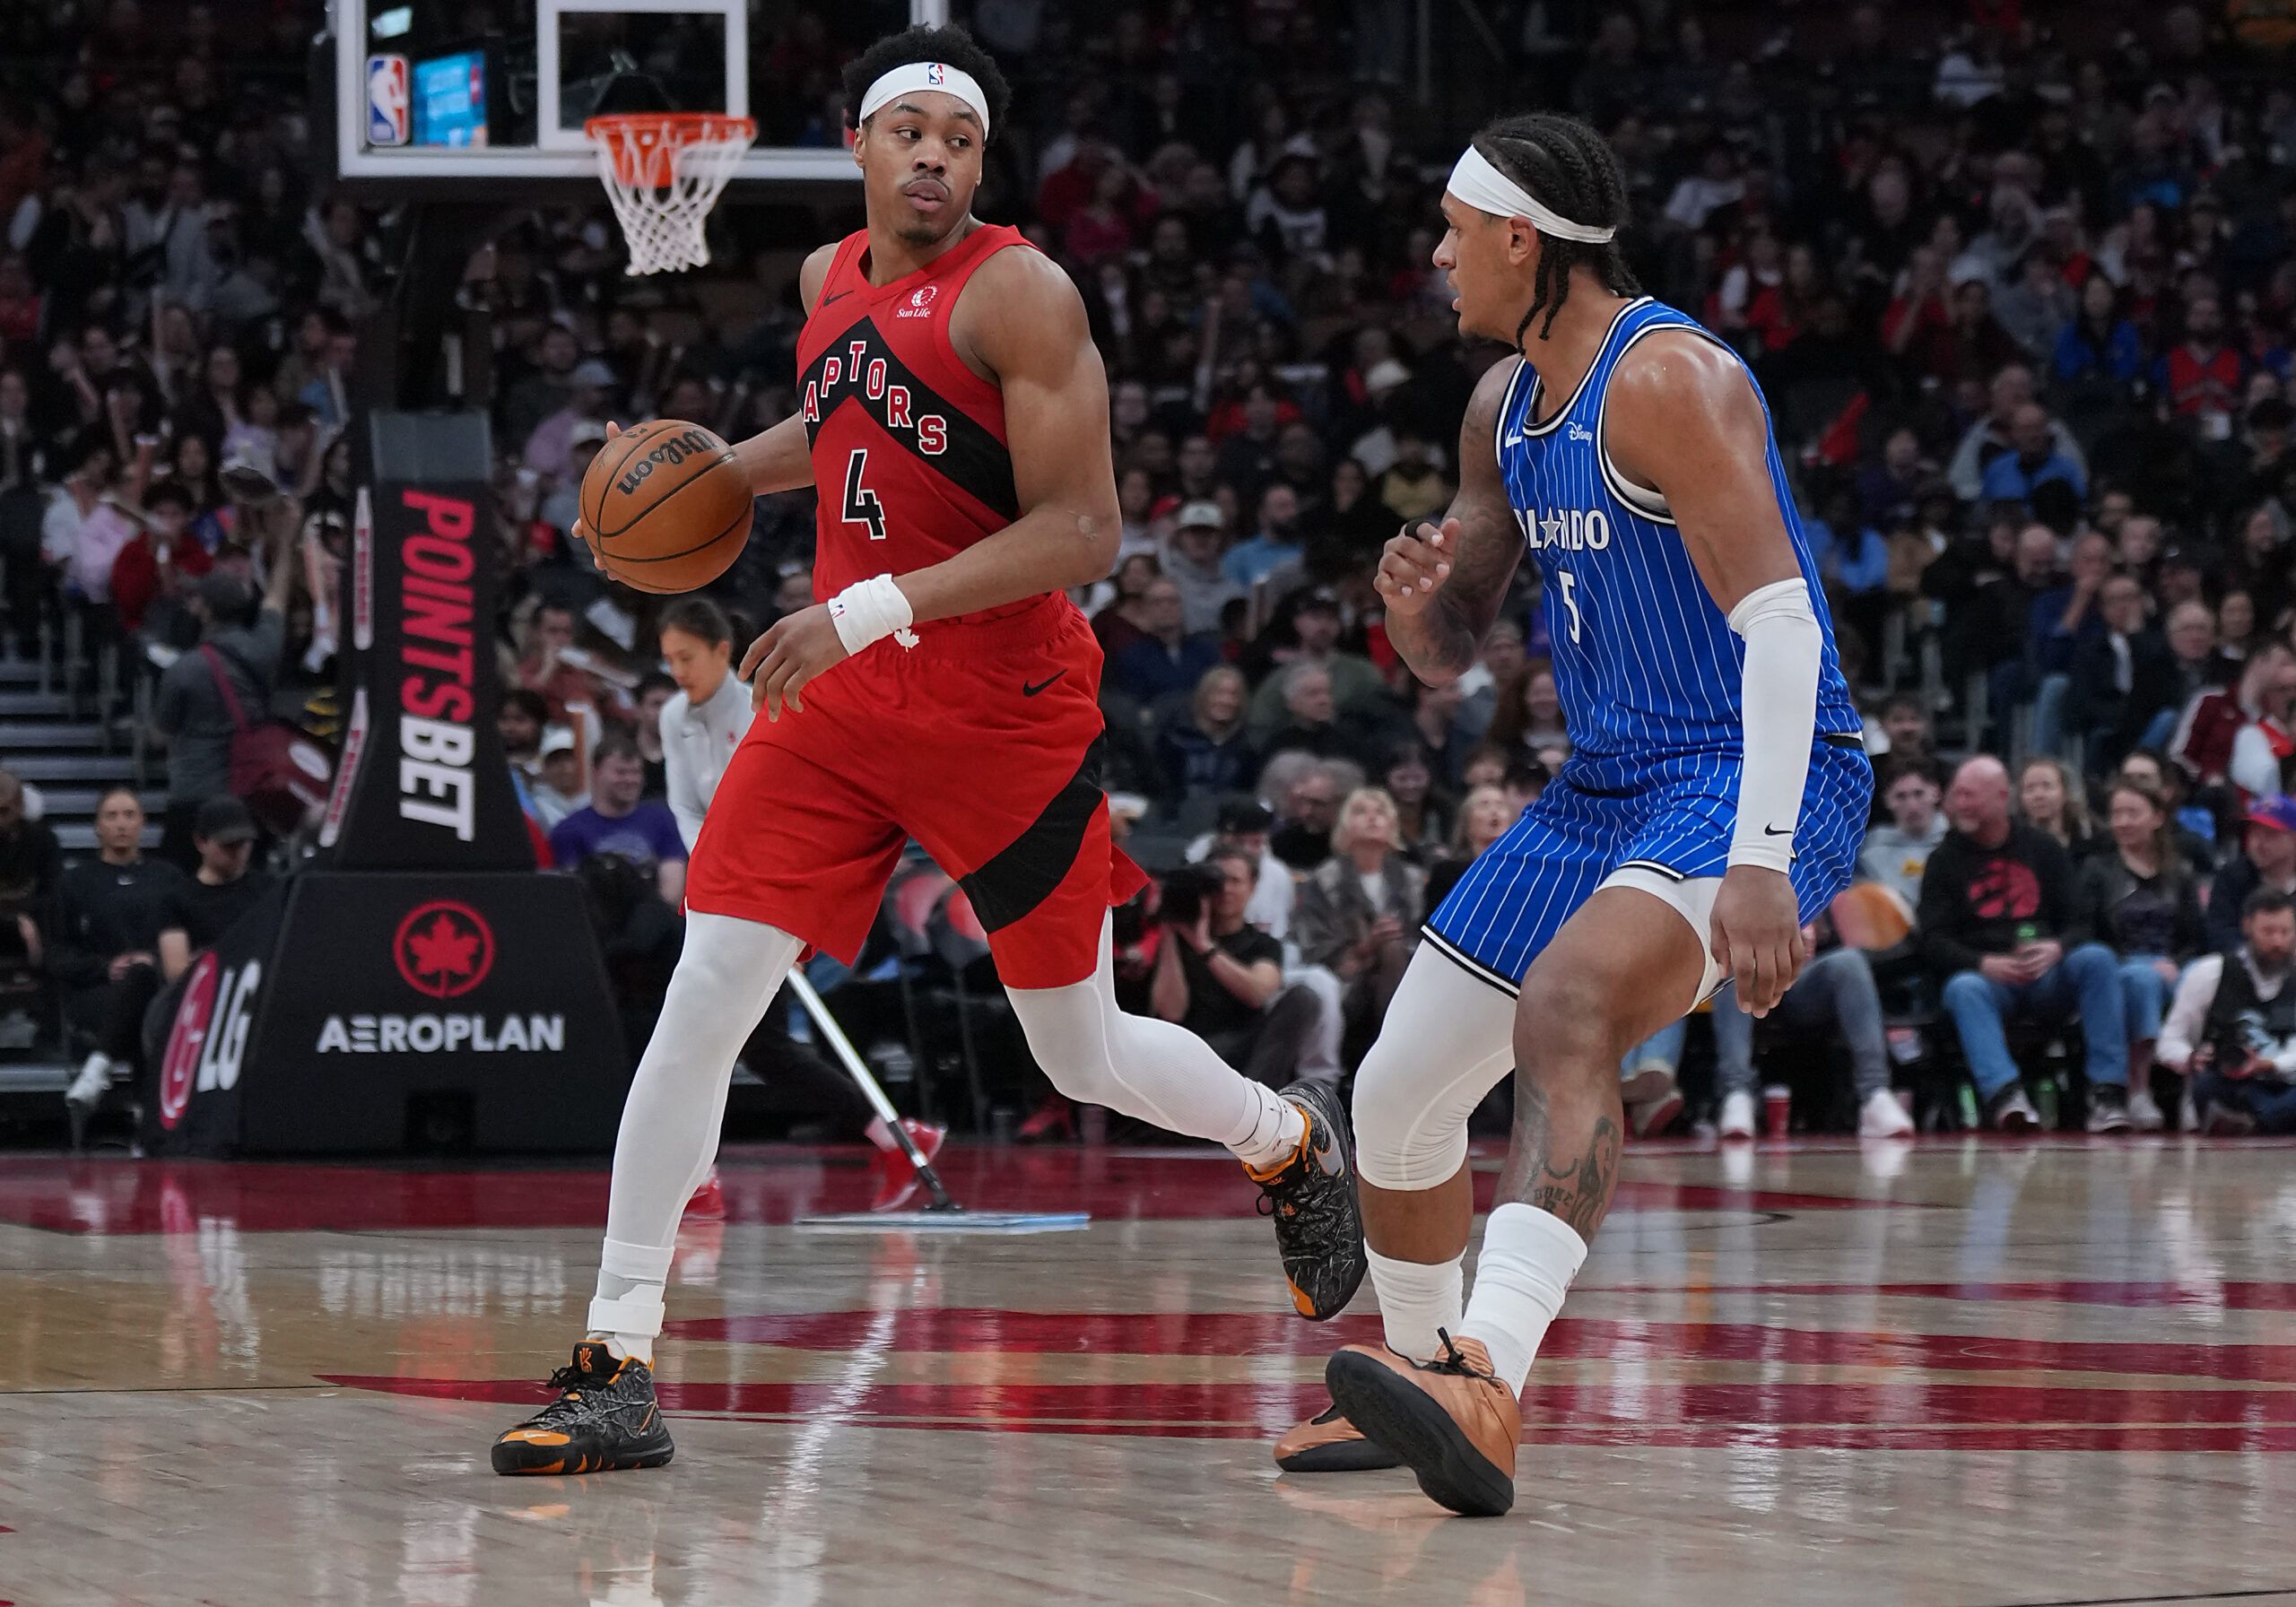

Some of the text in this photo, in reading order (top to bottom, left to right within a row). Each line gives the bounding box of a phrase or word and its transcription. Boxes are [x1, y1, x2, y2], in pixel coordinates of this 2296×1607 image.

[897, 308, 930, 317] Sun Life
[617, 430, 718, 495] Wilson
[1567, 421, 1593, 447] Disney
[841, 448, 886, 540] 4
[1558, 569, 1580, 645] 5
[401, 488, 475, 842] POINTSBET
[196, 959, 261, 1092] LG
[317, 1013, 565, 1054] AEROPLAN
